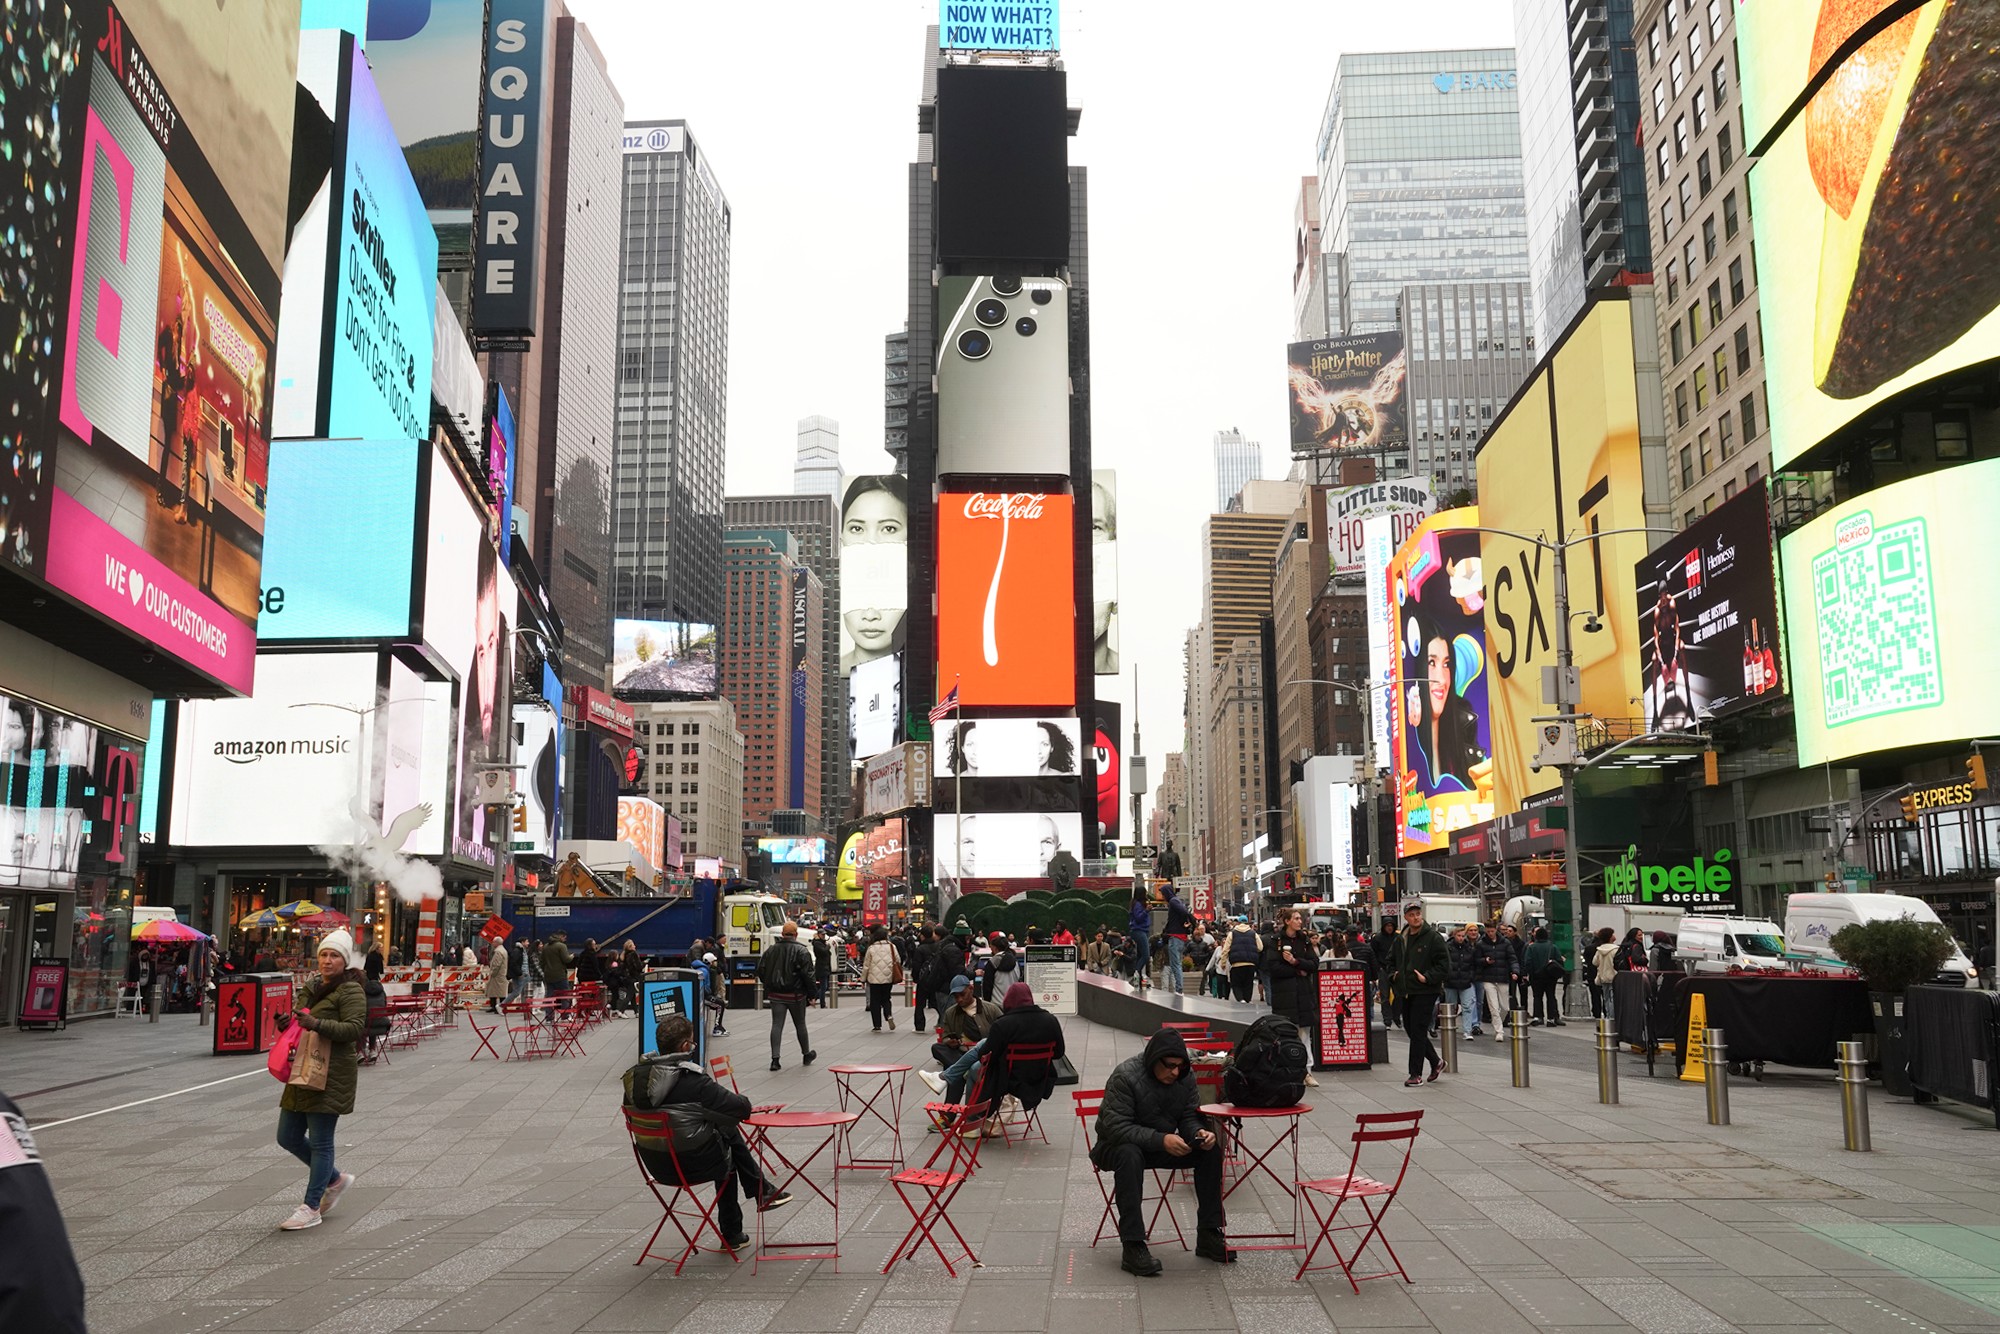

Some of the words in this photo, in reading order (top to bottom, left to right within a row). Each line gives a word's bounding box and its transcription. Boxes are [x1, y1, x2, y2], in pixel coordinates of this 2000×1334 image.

[947, 5, 987, 23] NOW
[992, 6, 1053, 25] WHAT?
[947, 26, 987, 43] NOW
[992, 27, 1053, 45] WHAT?
[130, 48, 176, 129] MARRIOTT
[128, 72, 169, 145] MARQUIS
[484, 19, 528, 295] SQUARE
[352, 188, 397, 307] Skrillex
[204, 298, 235, 345] COVERAGE
[234, 331, 255, 369] BEYOND
[349, 244, 376, 324] Quest
[378, 297, 391, 344] for
[392, 325, 406, 376] Fire
[407, 353, 415, 394] &
[1330, 337, 1377, 348] BROADWAY
[346, 296, 371, 373] Don't
[372, 342, 387, 398] Get
[389, 369, 401, 422] Too
[1309, 354, 1345, 378] Harry
[1345, 349, 1382, 369] Potter
[1338, 486, 1387, 518] LITTLE
[1390, 485, 1427, 507] SHOP
[1337, 563, 1362, 572] Westside
[1707, 544, 1736, 571] Hennessy
[106, 553, 127, 595] WE
[145, 582, 169, 622] OUR
[170, 598, 227, 658] CUSTOMERS
[869, 693, 880, 712] all
[1391, 685, 1399, 739] STORE
[1375, 706, 1383, 738] SIGNAGE
[214, 740, 286, 755] amazon
[291, 735, 351, 754] music
[914, 746, 926, 803] HELLO!
[1913, 783, 1972, 810] EXPRESS
[1604, 844, 1638, 904] pelé
[1640, 848, 1732, 902] pelé
[869, 882, 883, 911] tkts
[1195, 887, 1209, 911] kts
[1612, 895, 1633, 904] SOCCER
[1663, 894, 1720, 902] SOCCER
[36, 974, 59, 982] FREE
[652, 989, 674, 999] EXPLORE
[660, 1001, 675, 1009] TIMES
[655, 1007, 675, 1017] SQUARE
